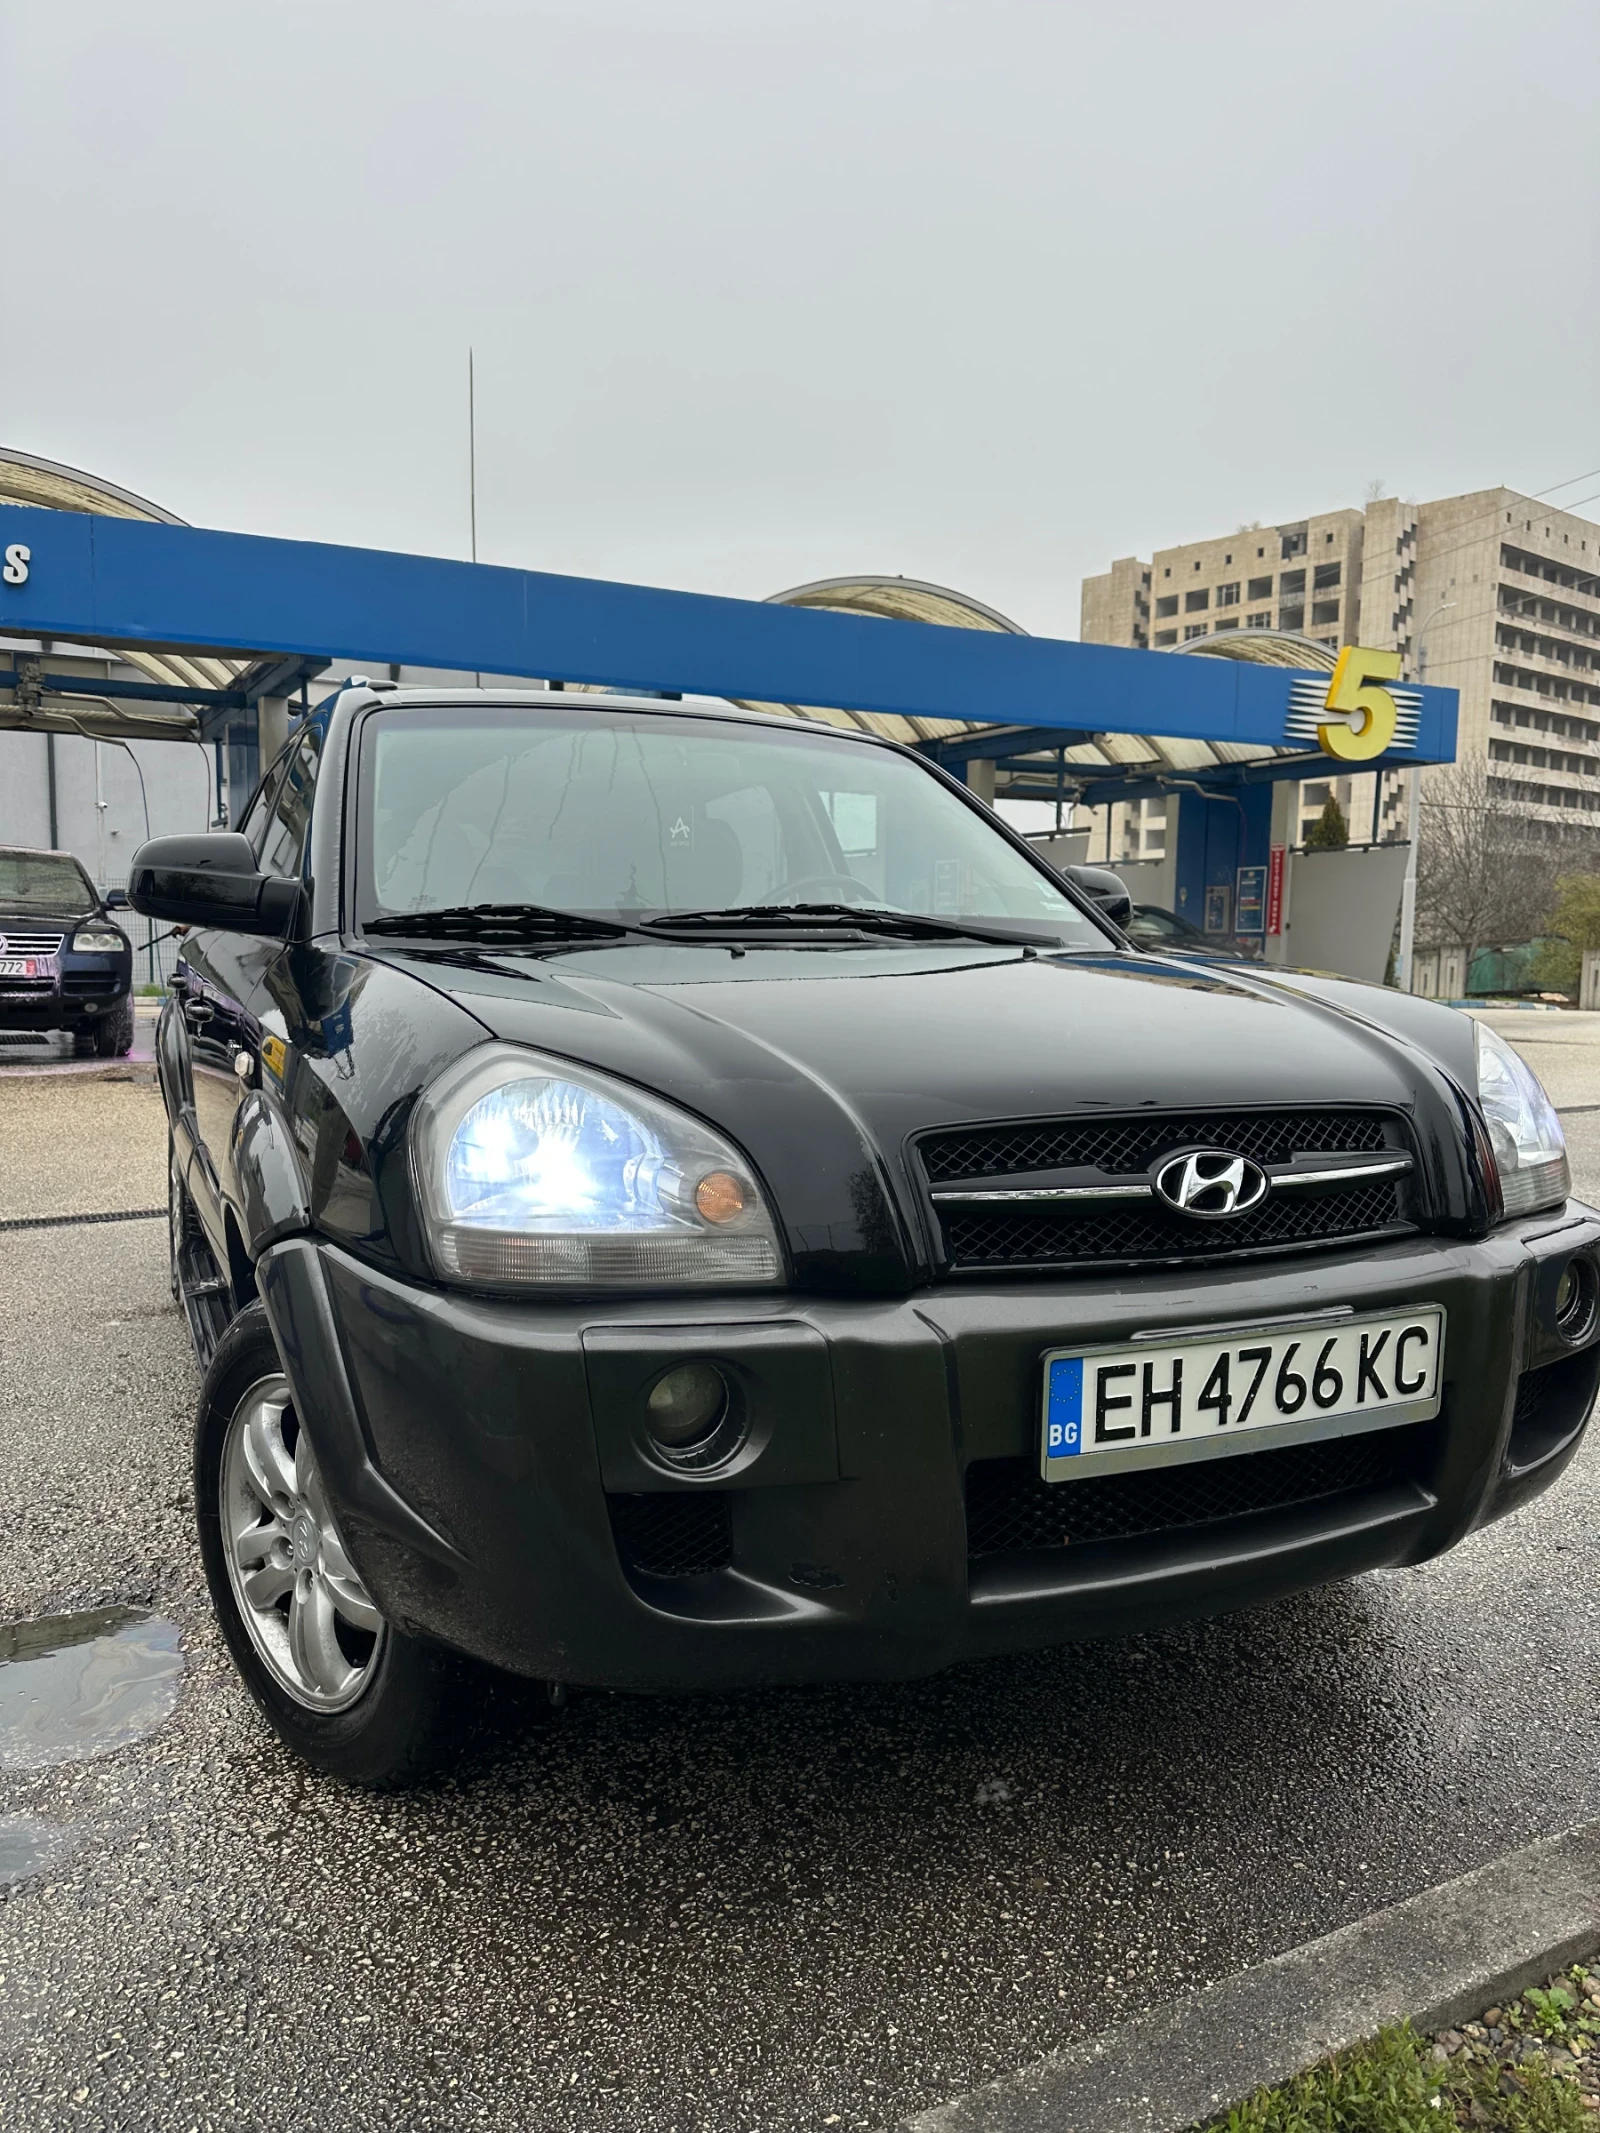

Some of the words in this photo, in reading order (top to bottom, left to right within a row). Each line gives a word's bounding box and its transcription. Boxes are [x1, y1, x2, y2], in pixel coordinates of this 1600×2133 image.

[3, 544, 30, 583] S
[1317, 645, 1402, 761] 5
[1094, 1358, 1183, 1444] EH
[1197, 1337, 1344, 1426] 4766
[1356, 1325, 1430, 1404] KC
[1049, 1421, 1078, 1447] BG
